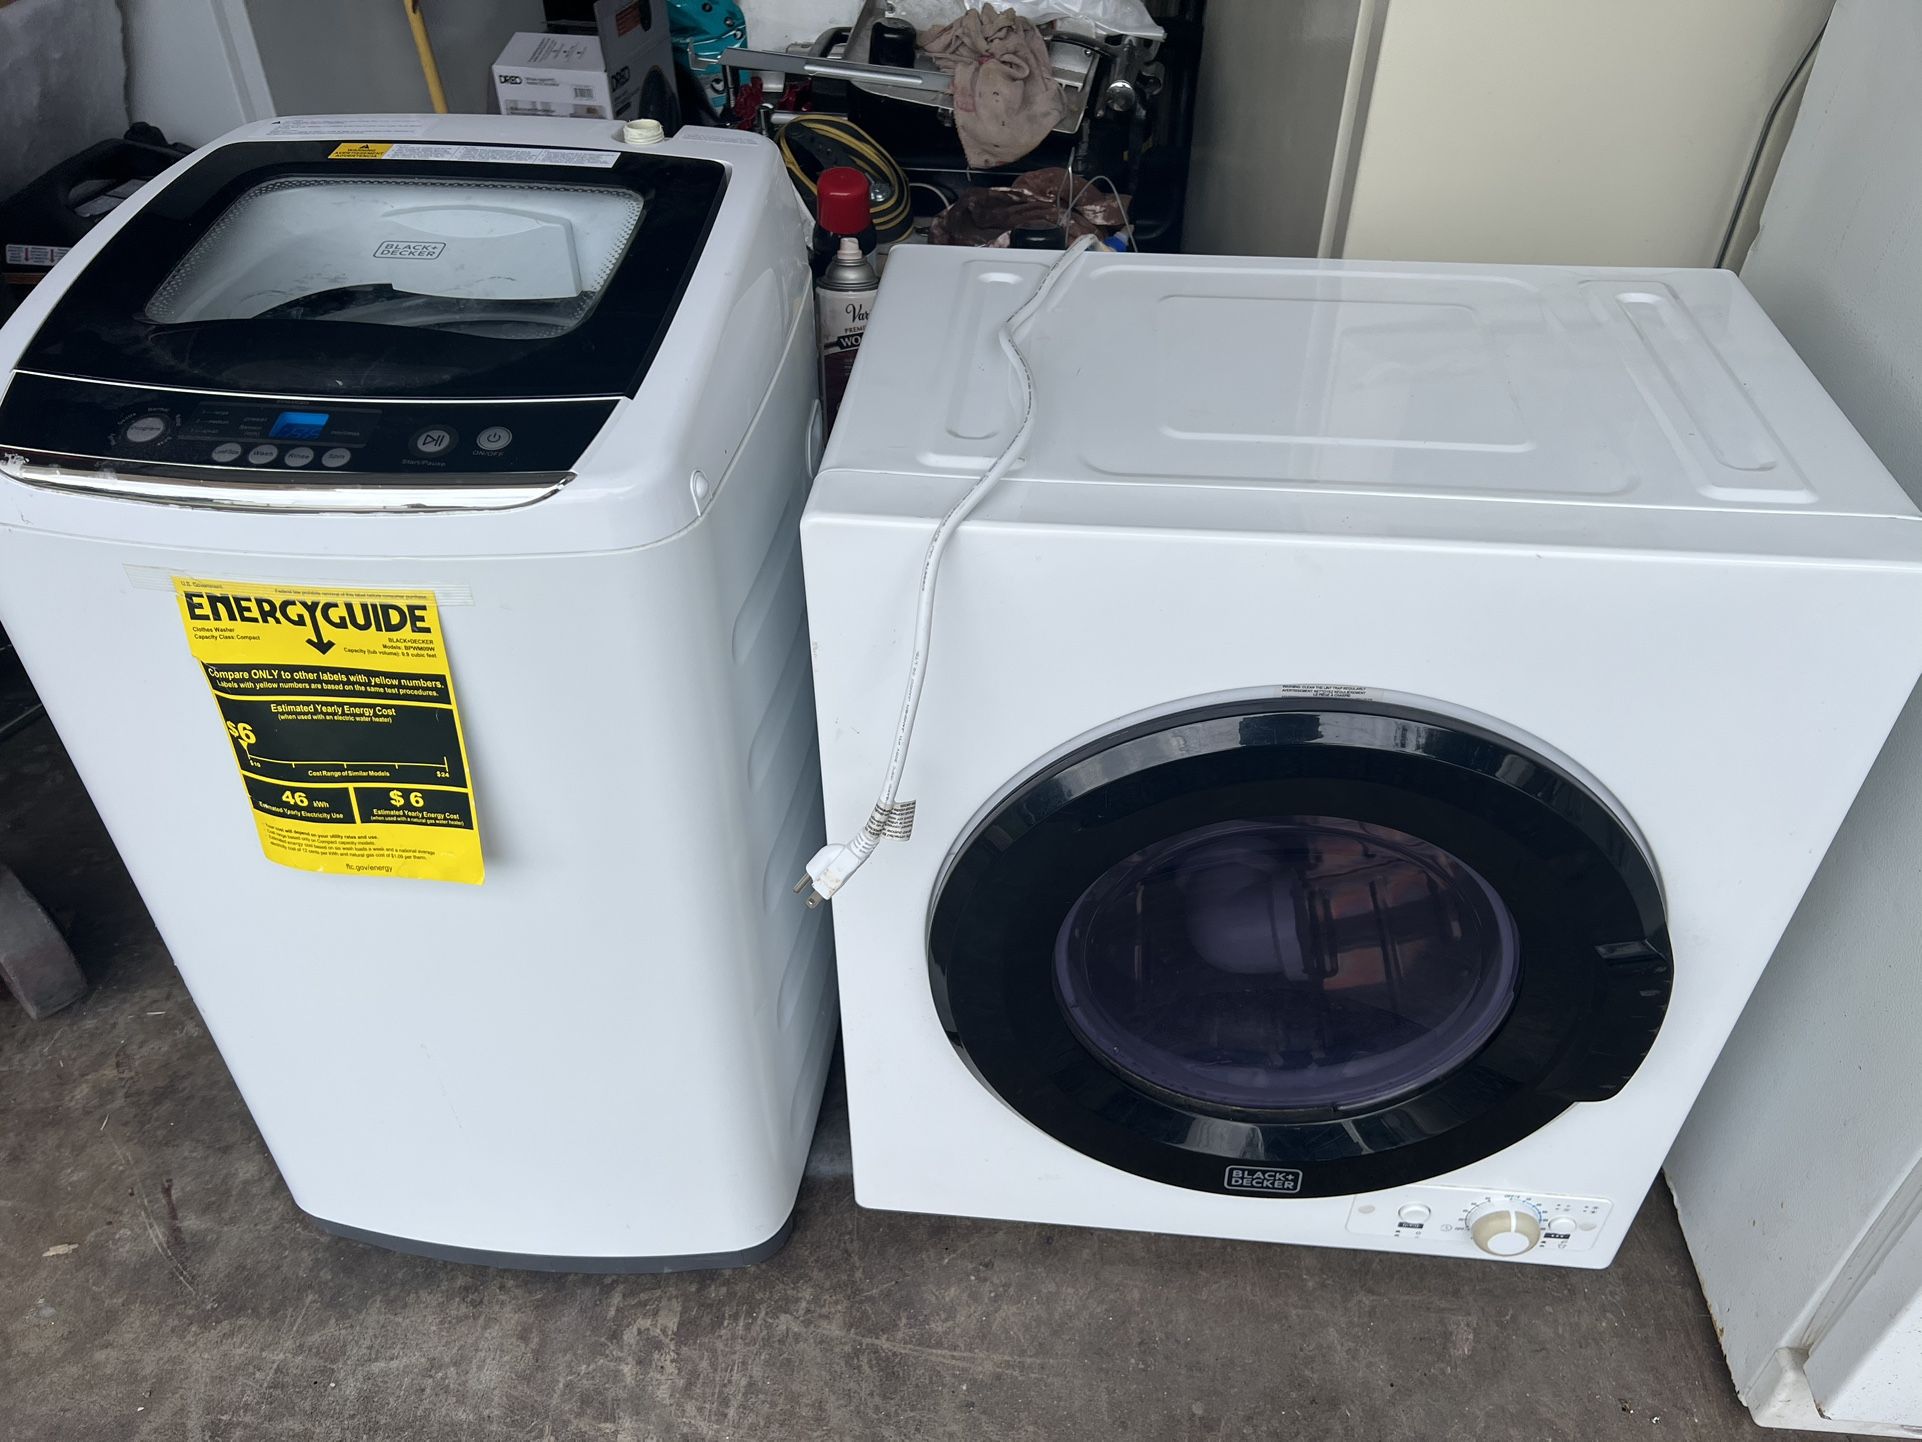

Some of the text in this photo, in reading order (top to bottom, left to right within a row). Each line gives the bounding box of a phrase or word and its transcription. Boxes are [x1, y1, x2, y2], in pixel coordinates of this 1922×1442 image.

[380, 249, 436, 257] DECKER
[845, 304, 869, 323] Var
[840, 335, 861, 347] WO
[184, 591, 432, 634] ENERGYGUIDE
[208, 668, 444, 688] Compare ONLY to other labels with yellow numbers.
[216, 680, 239, 689] Labels
[255, 682, 278, 690] yellow
[399, 688, 439, 696] procedures.
[271, 704, 396, 716] Estimated Yearly Energy Cost
[226, 720, 257, 744] $6
[282, 790, 309, 807] 46
[258, 801, 283, 813] Estimated
[301, 811, 330, 819] Electricity
[404, 809, 422, 818] Yearly
[423, 811, 444, 819] Energy
[1231, 1177, 1294, 1189] DECKER
[1232, 1170, 1295, 1181] BLACK+
